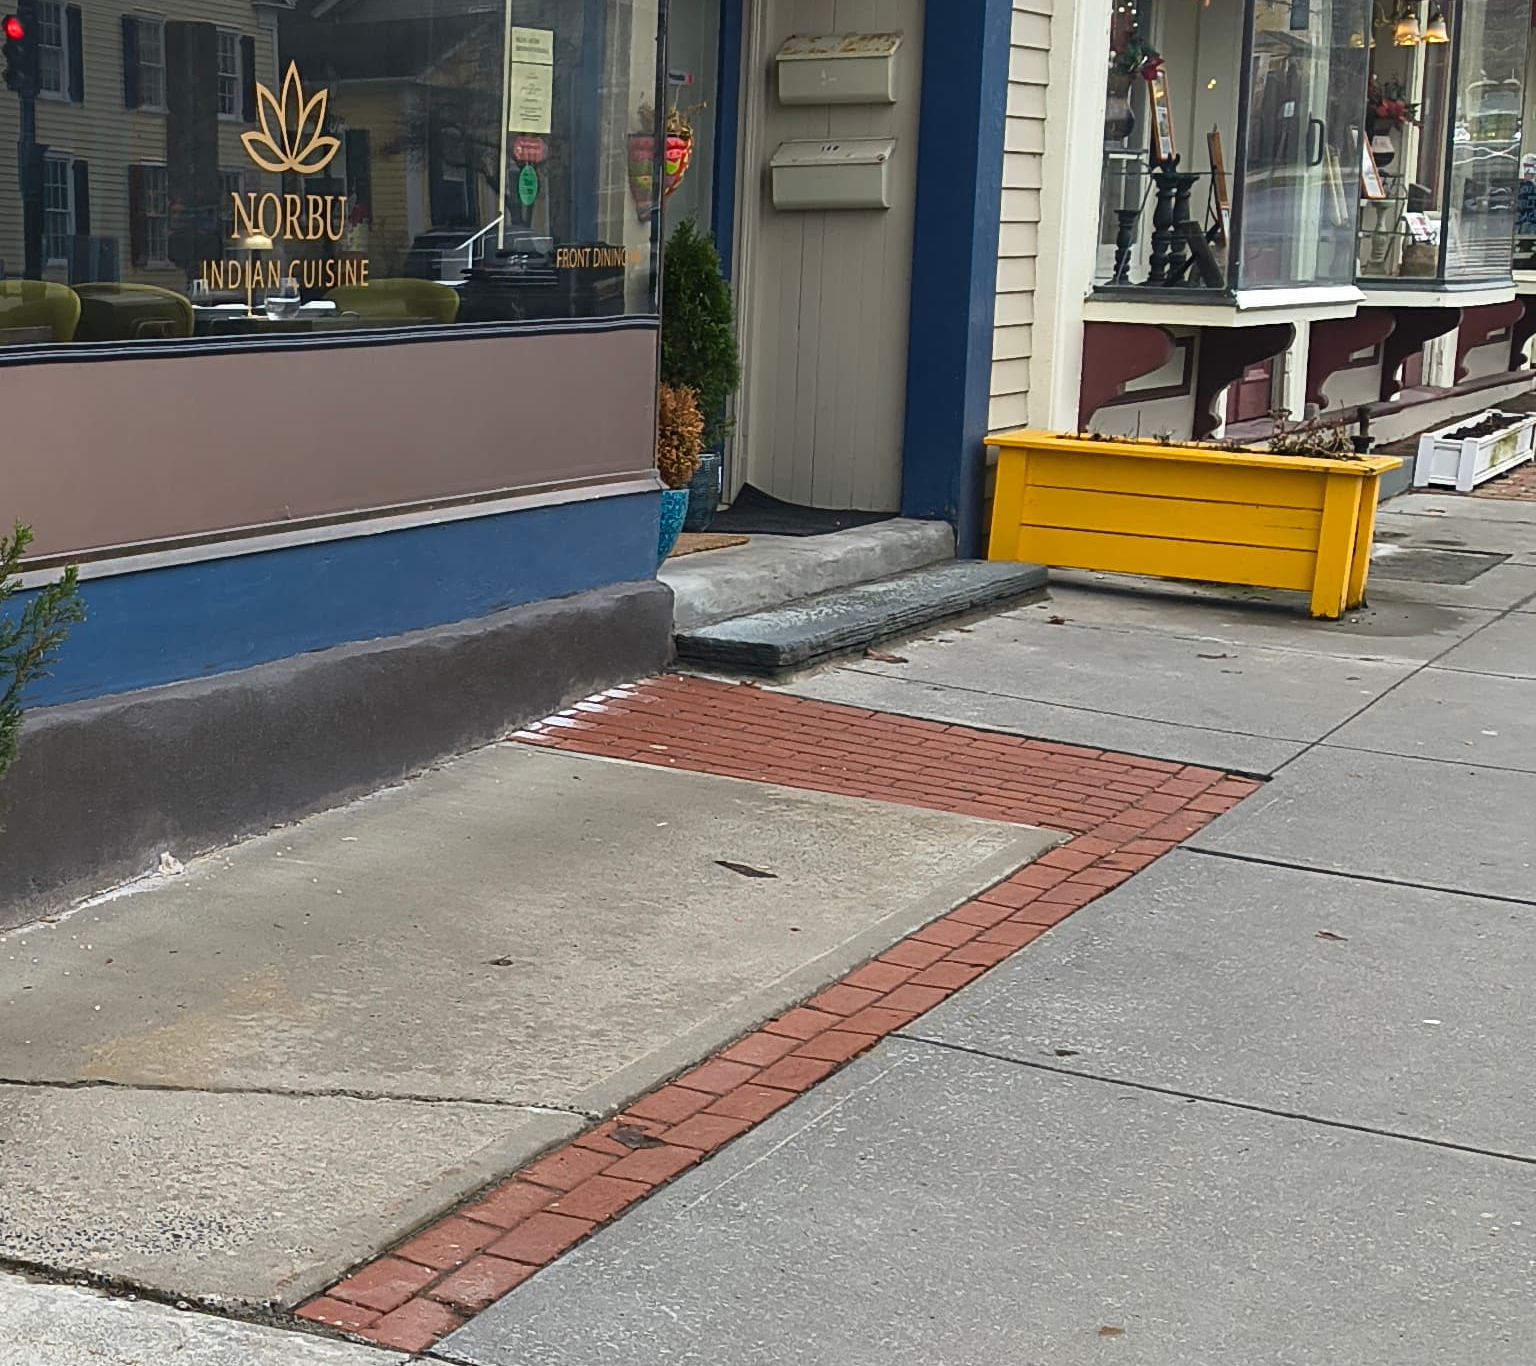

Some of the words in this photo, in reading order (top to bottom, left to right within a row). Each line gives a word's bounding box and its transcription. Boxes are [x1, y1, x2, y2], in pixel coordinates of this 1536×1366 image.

[230, 192, 348, 241] NORBU
[555, 247, 591, 268] FRONT
[592, 247, 628, 268] DINING
[202, 259, 281, 290] INDIAN
[287, 259, 370, 290] CUISINE
